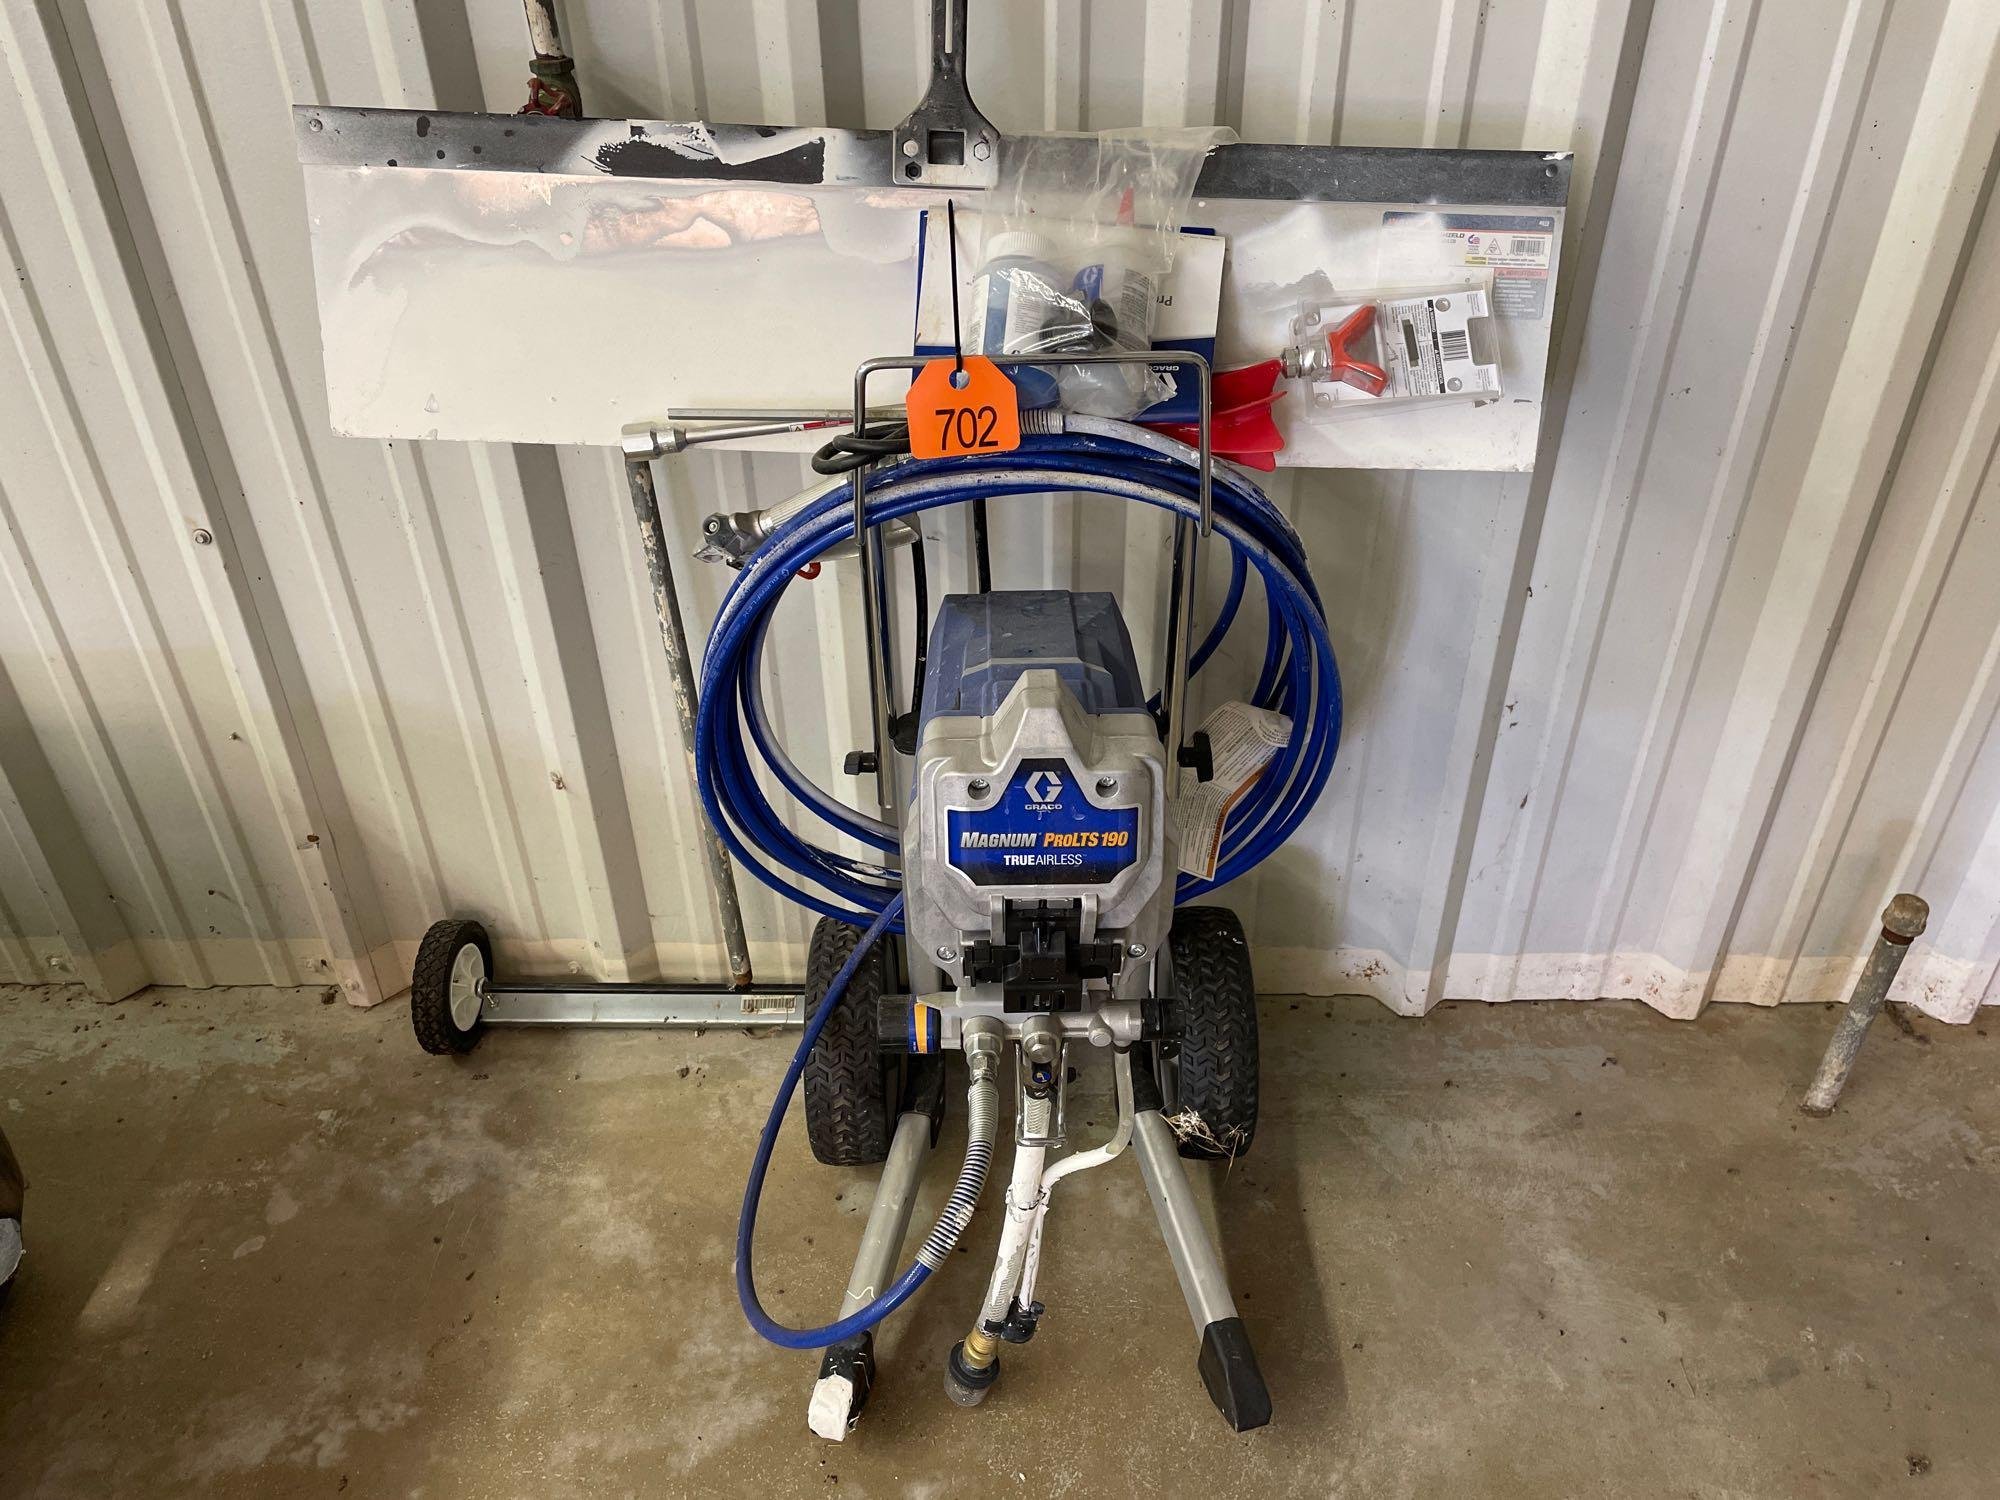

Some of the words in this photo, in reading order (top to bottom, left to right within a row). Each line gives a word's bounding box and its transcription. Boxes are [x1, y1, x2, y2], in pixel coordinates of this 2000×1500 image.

[935, 406, 999, 451] 702
[960, 831, 1037, 849] MAGNUM
[1003, 853, 1083, 866] TRUEAIRLESS
